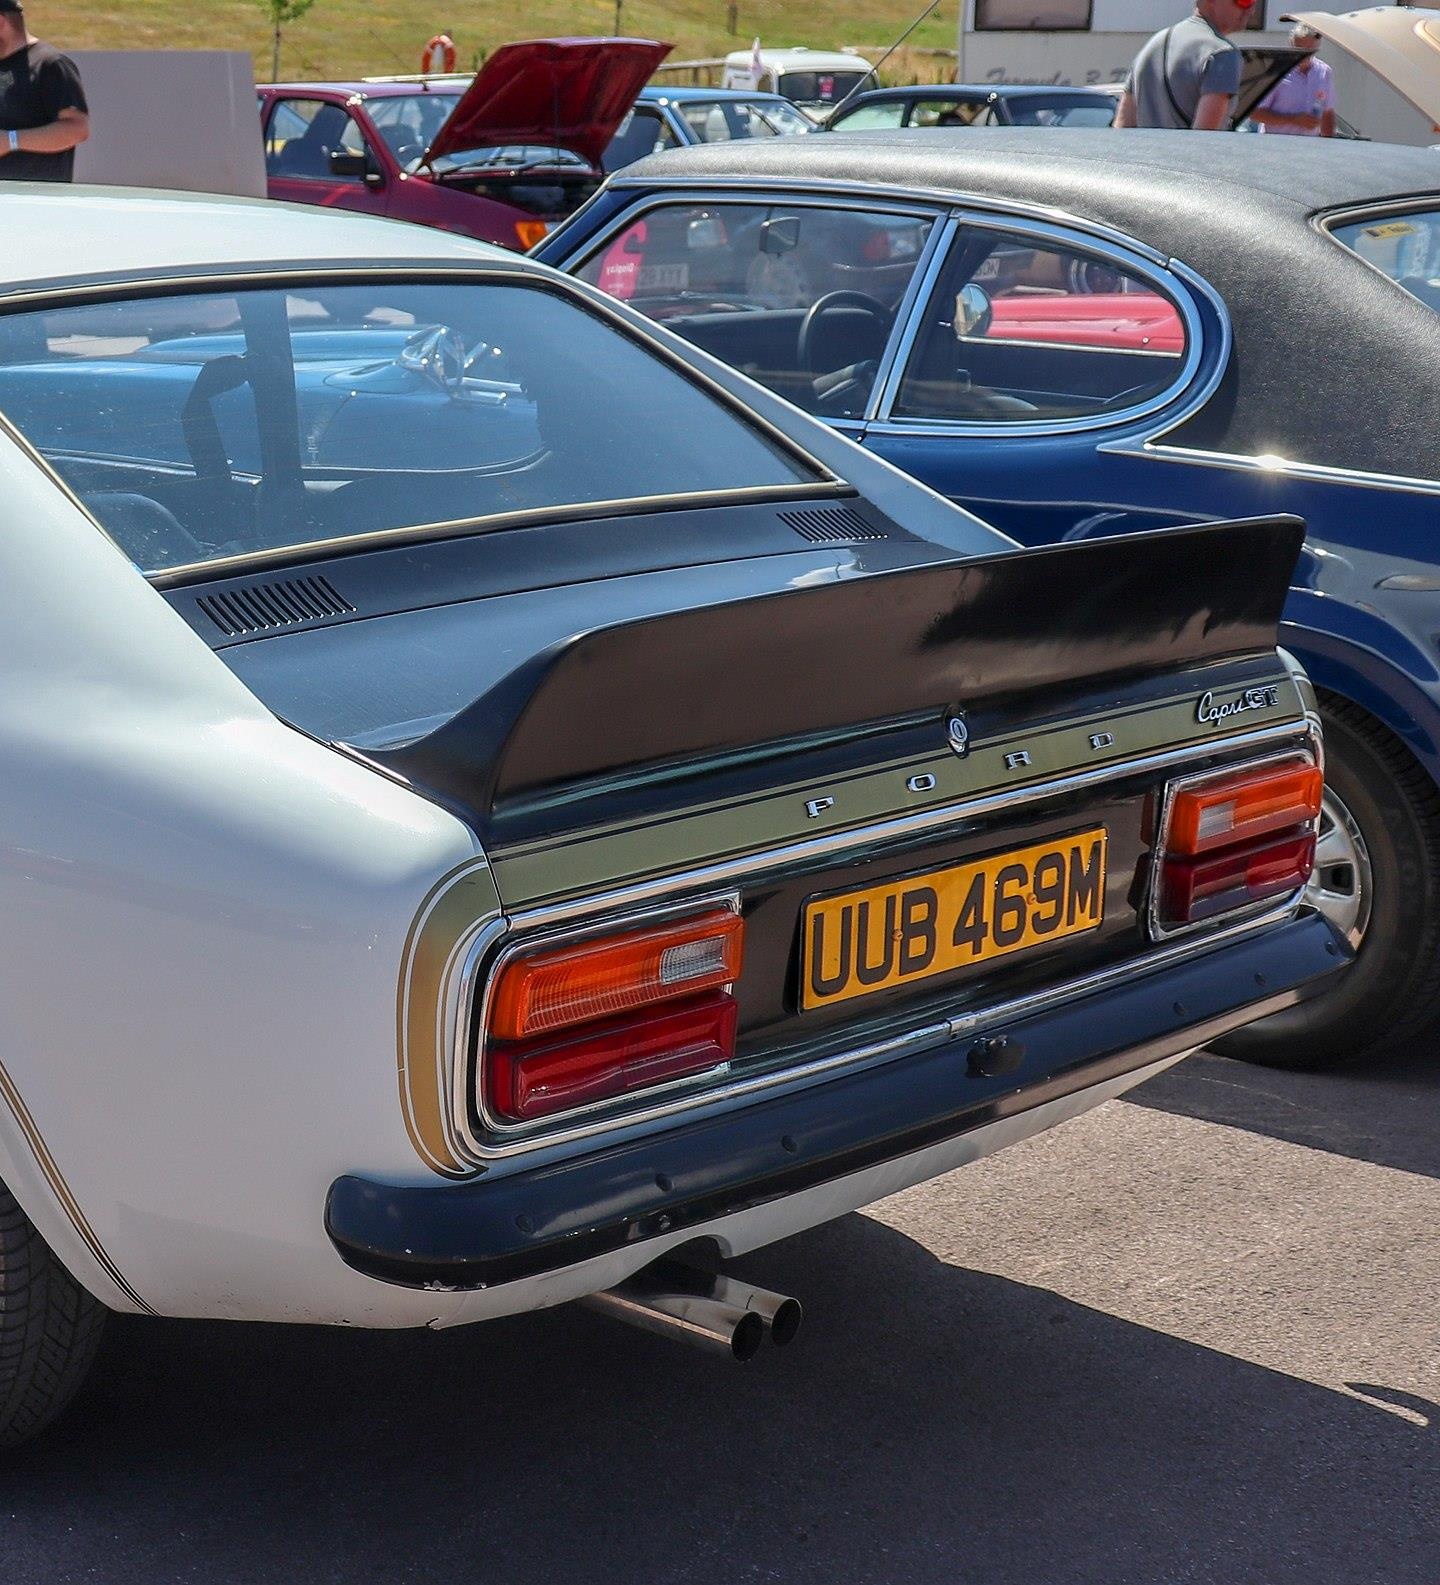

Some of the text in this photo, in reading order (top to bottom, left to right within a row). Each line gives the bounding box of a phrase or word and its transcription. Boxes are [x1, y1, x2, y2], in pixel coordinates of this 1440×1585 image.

[1198, 685, 1279, 725] Capri GT
[805, 731, 1114, 818] FORD
[811, 841, 1102, 998] UUB 469M
